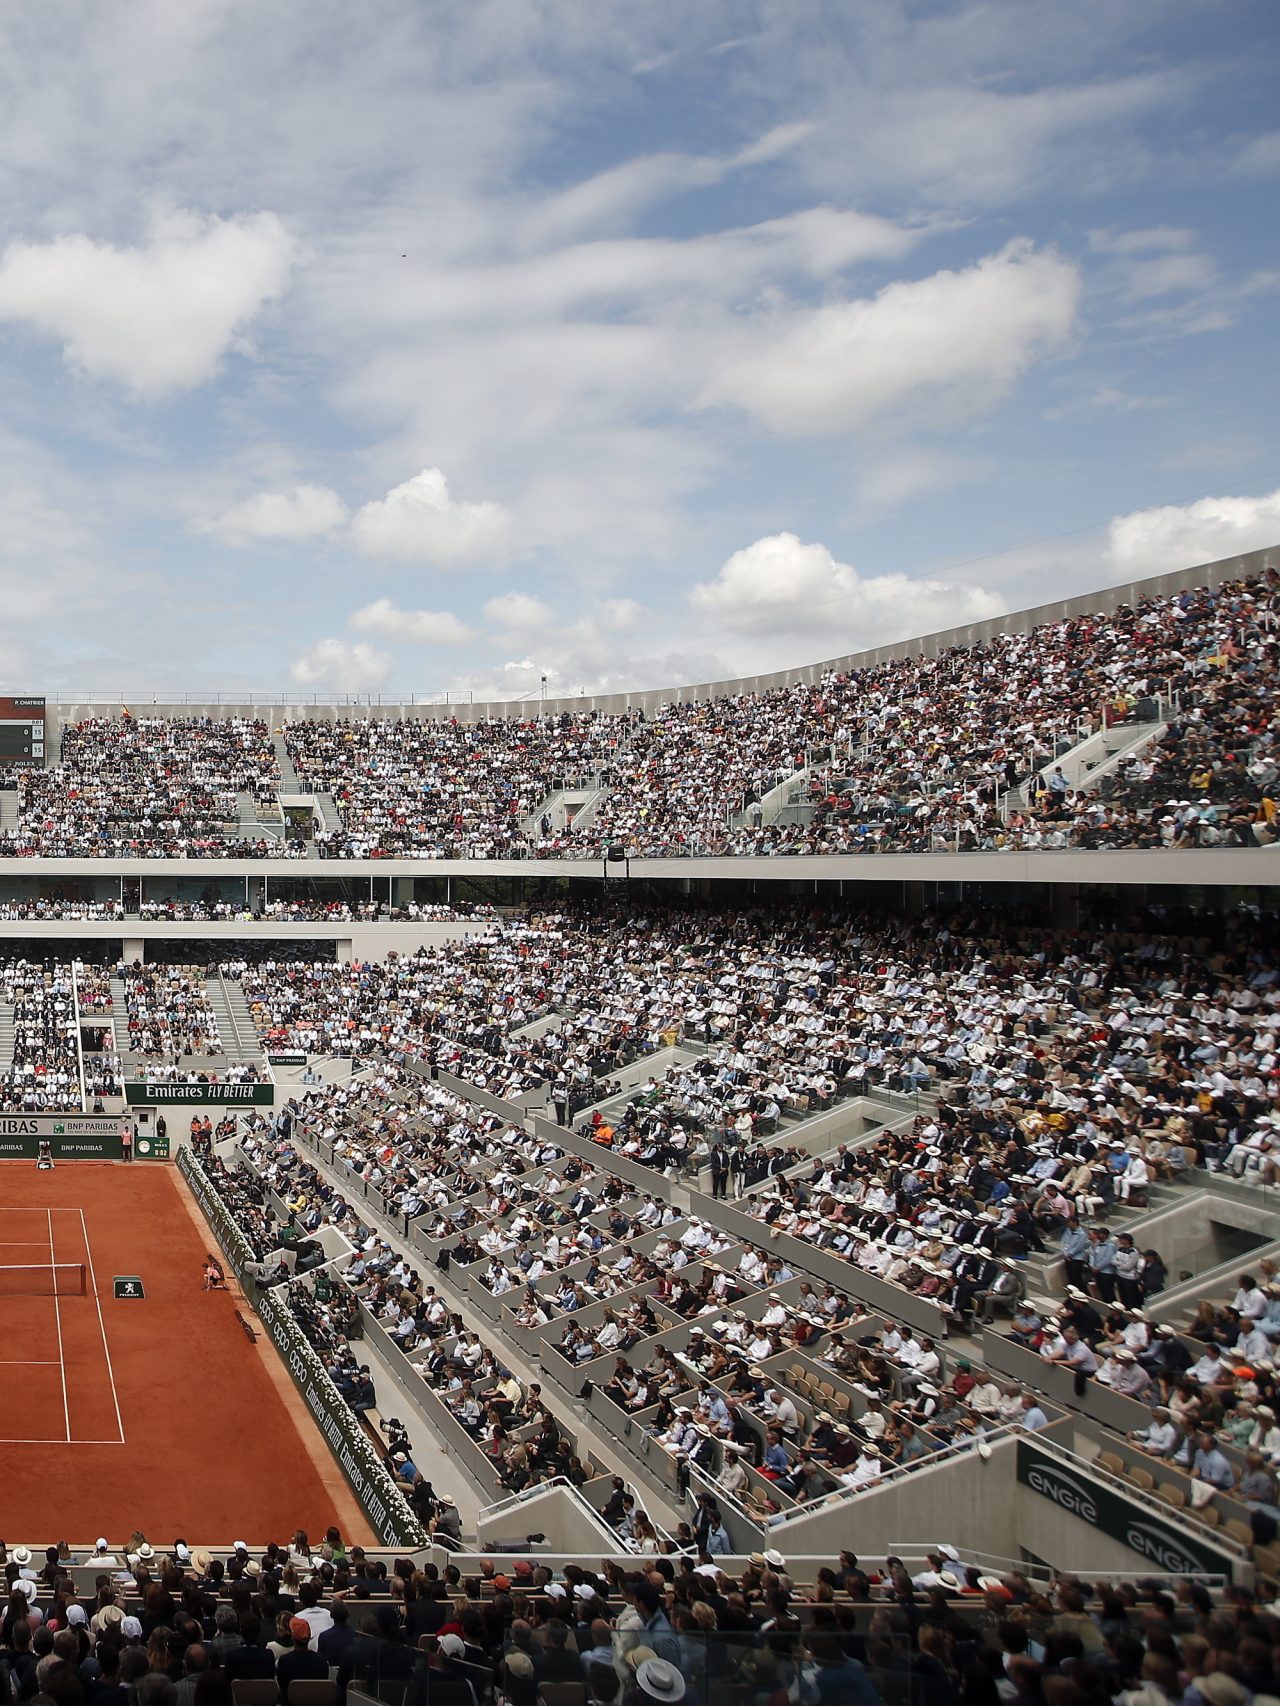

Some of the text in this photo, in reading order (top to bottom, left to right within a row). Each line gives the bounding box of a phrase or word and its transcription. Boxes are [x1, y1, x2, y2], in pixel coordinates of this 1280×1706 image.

[146, 1085, 254, 1098] Emirates FLY BETTER
[67, 1122, 118, 1130] BNP PARIBAS
[260, 1298, 274, 1324] oppo
[273, 1322, 289, 1352] oppo
[289, 1350, 307, 1382] oppo
[305, 1381, 343, 1451] Emirates FLY BETTER
[340, 1441, 387, 1528] Emirates FLY BETTER
